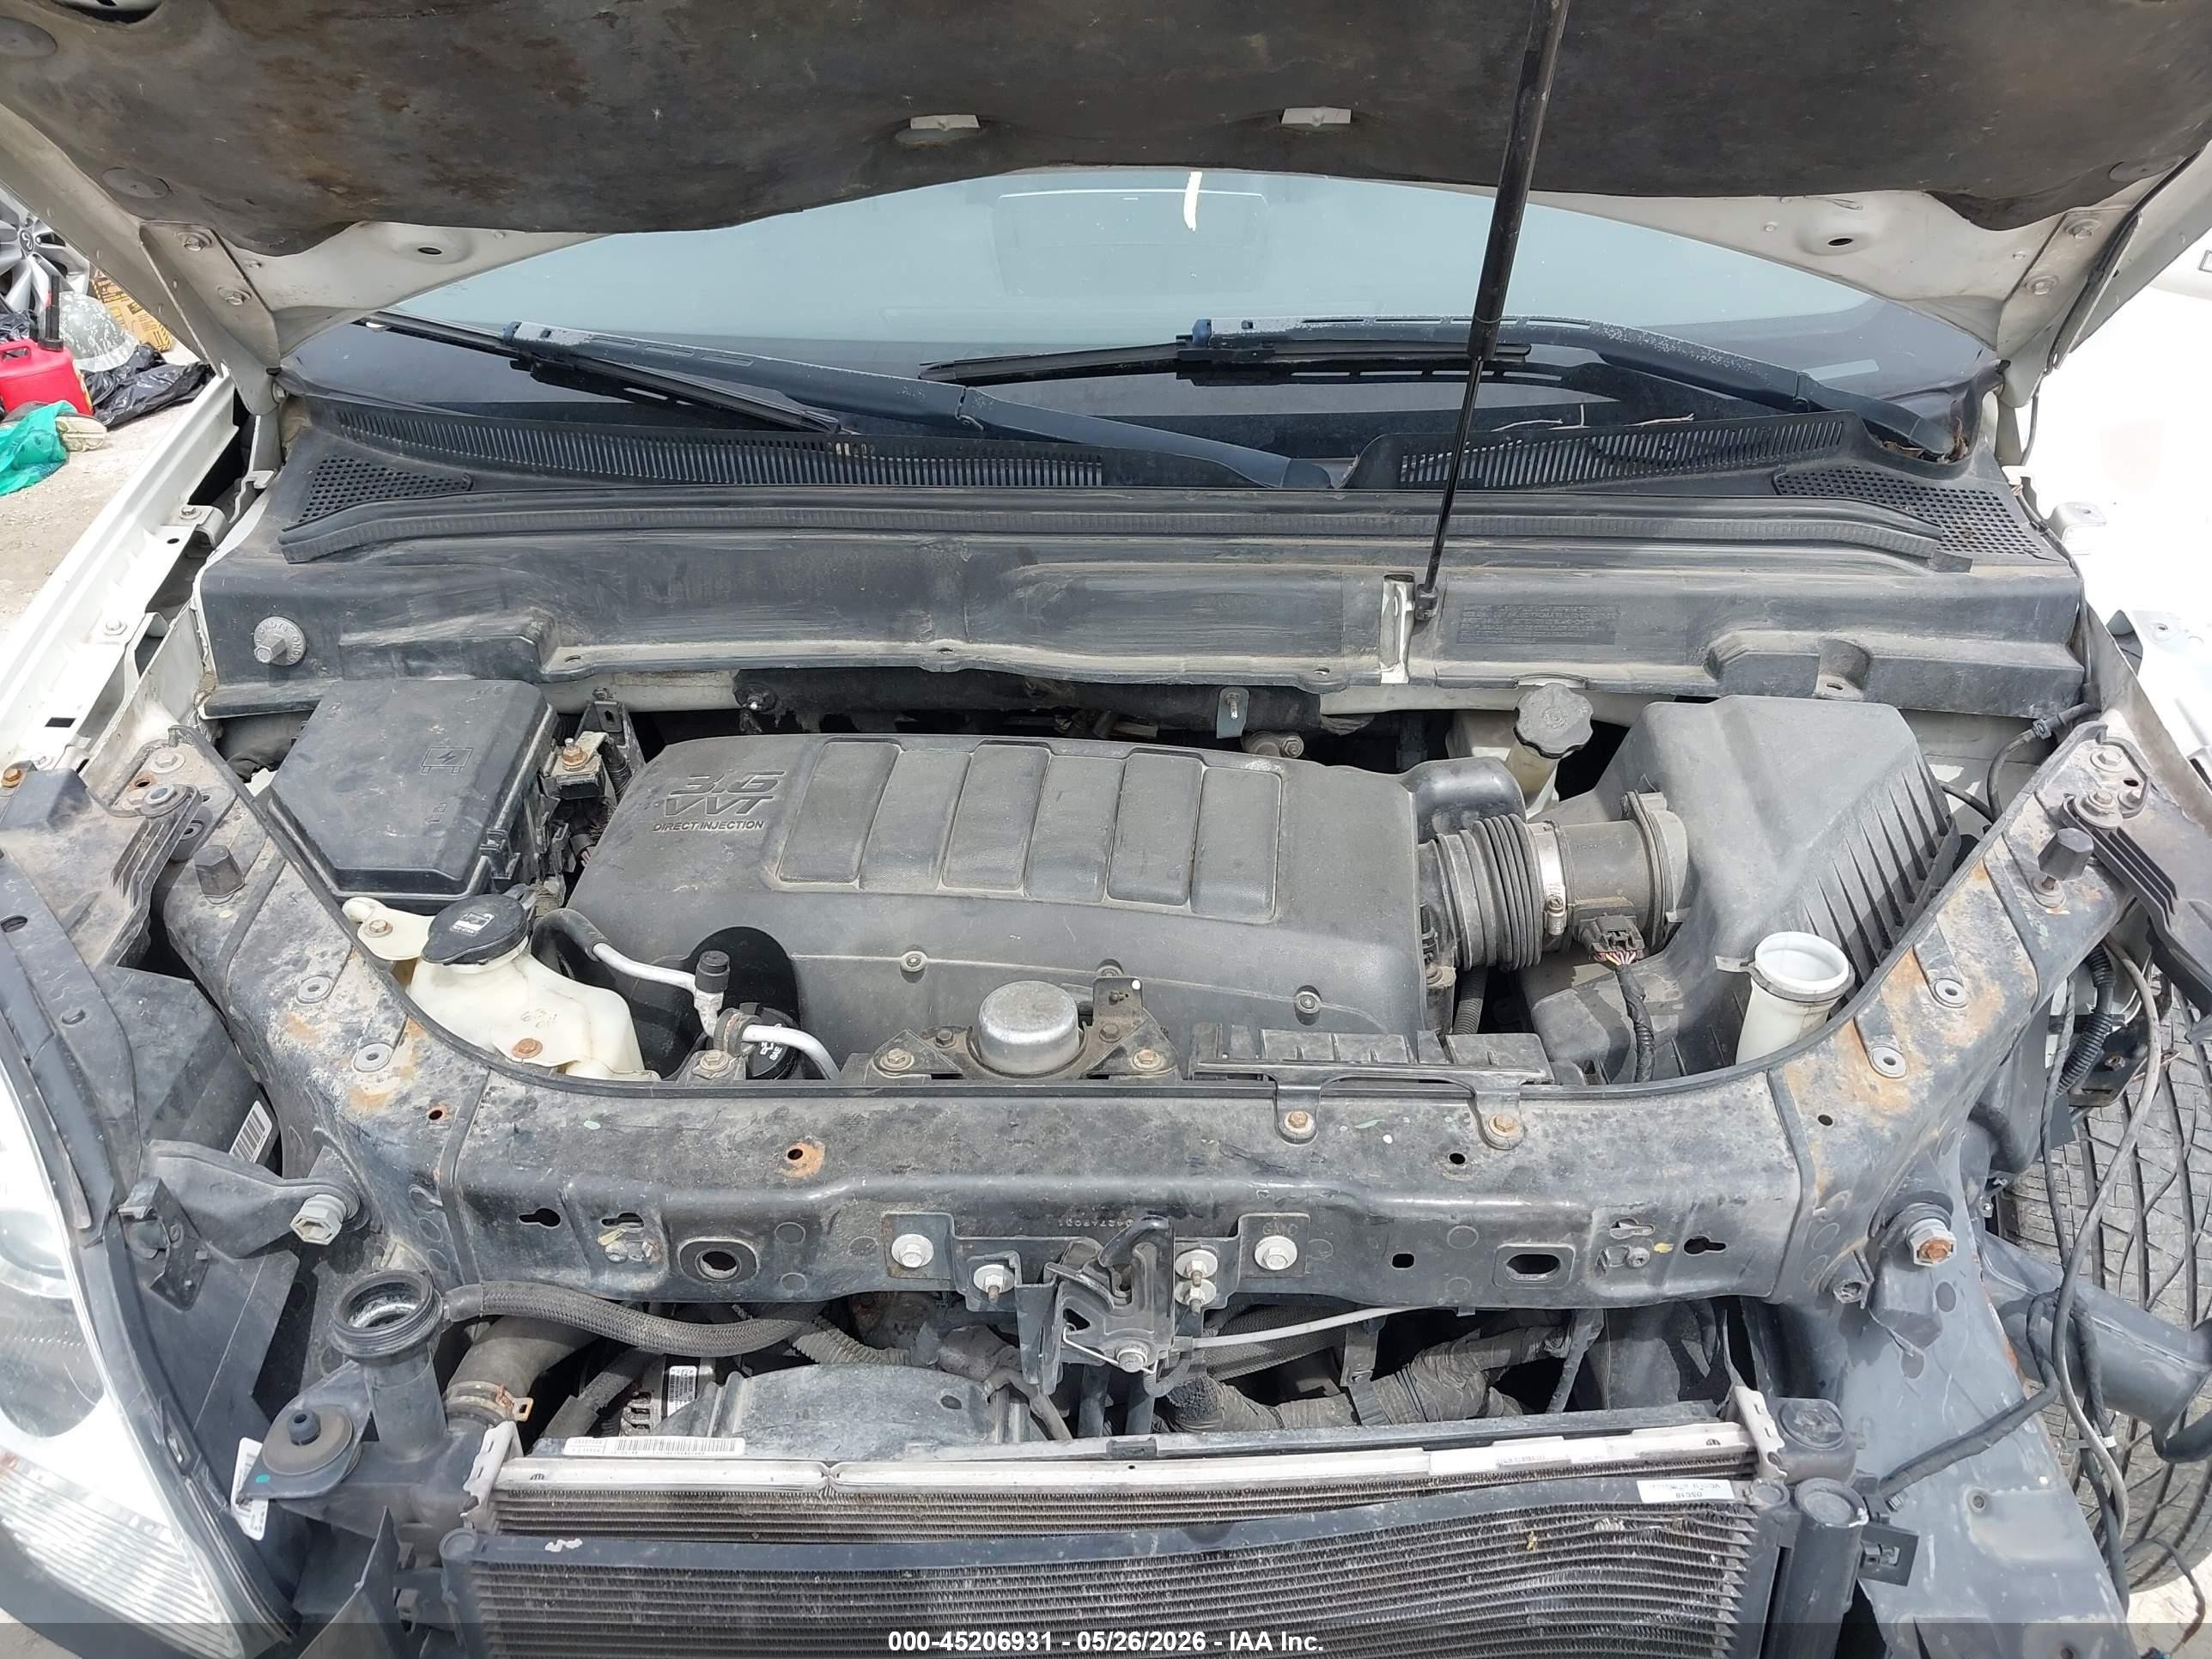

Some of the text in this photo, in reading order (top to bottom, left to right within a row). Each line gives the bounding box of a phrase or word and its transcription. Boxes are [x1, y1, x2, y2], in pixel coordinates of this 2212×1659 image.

[665, 795, 774, 817] VVT
[653, 819, 764, 832] DIRECT INJECTION
